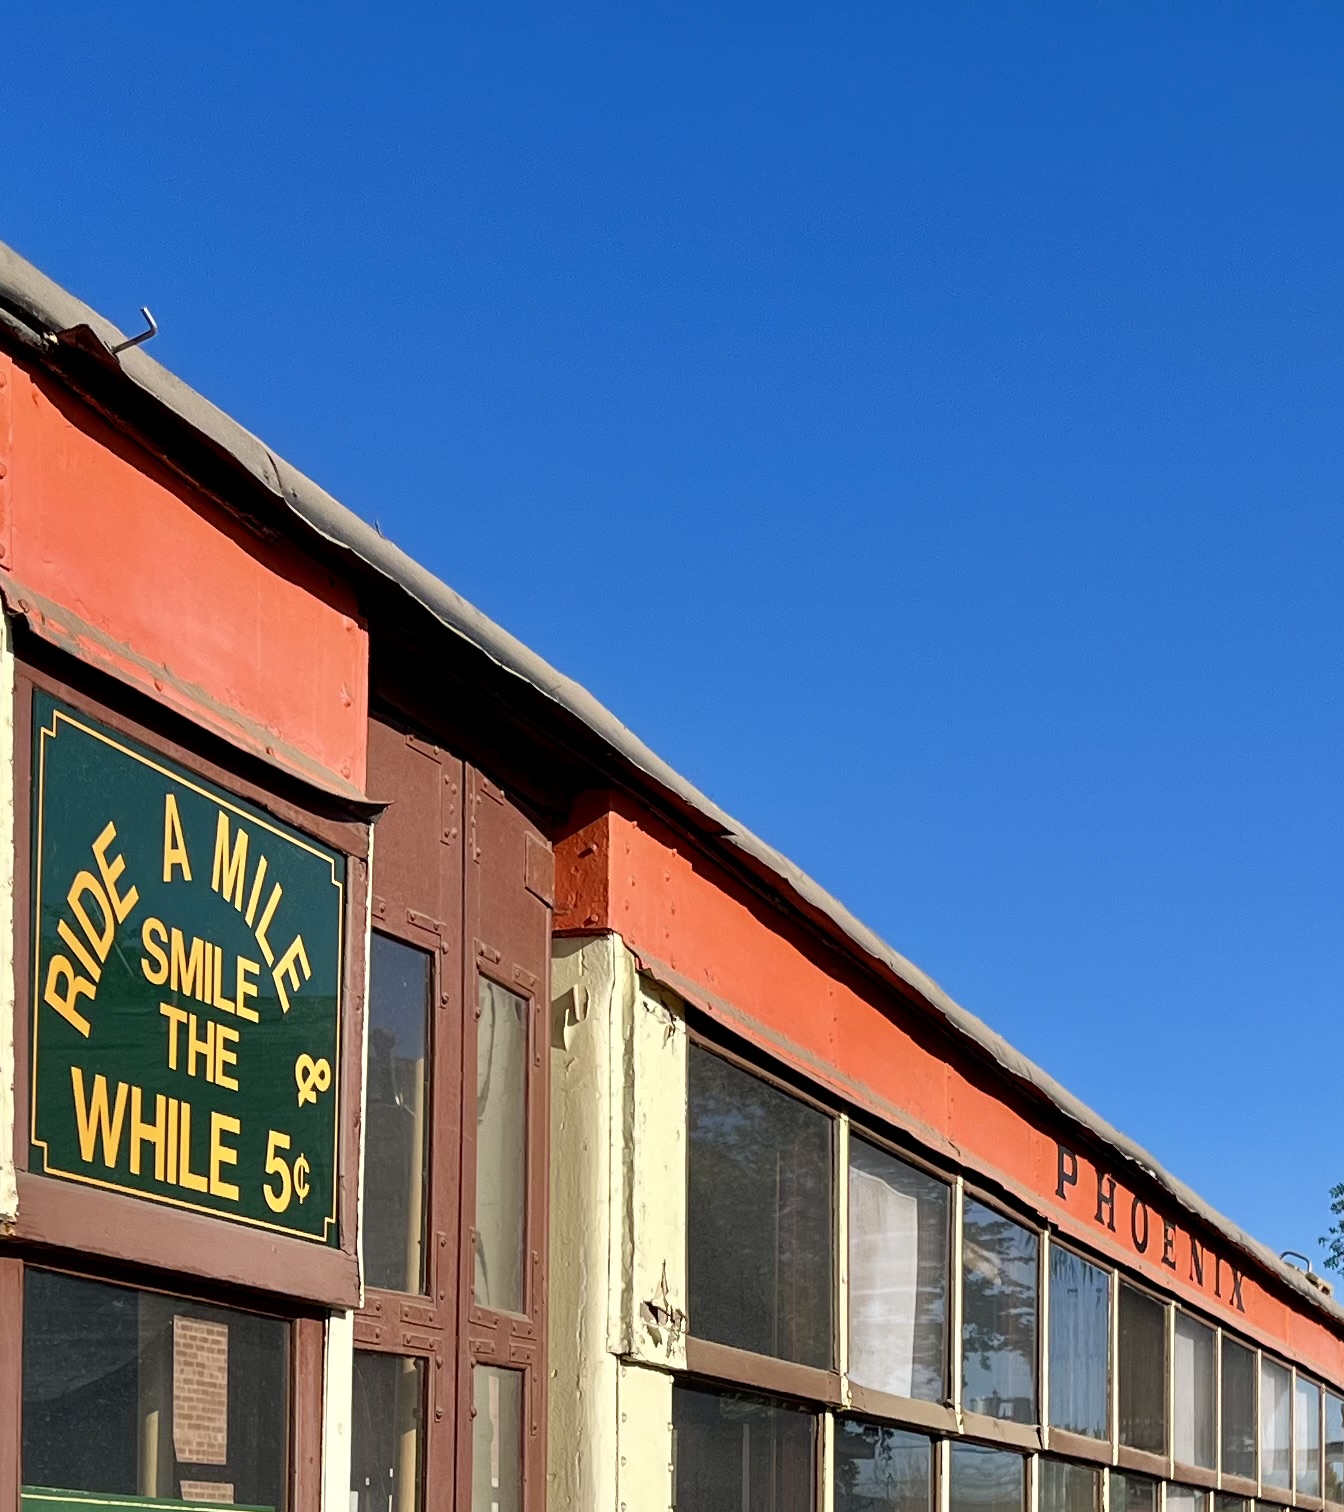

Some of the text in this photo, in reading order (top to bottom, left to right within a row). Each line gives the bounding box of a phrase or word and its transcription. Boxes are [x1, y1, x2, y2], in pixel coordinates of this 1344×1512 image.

[43, 793, 312, 1038] RIDE A MILE
[141, 916, 260, 1023] SMILE
[159, 1002, 240, 1092] THE
[294, 1052, 332, 1108] &
[70, 1065, 242, 1201] WHILE
[1055, 1143, 1246, 1314] PHOENIX
